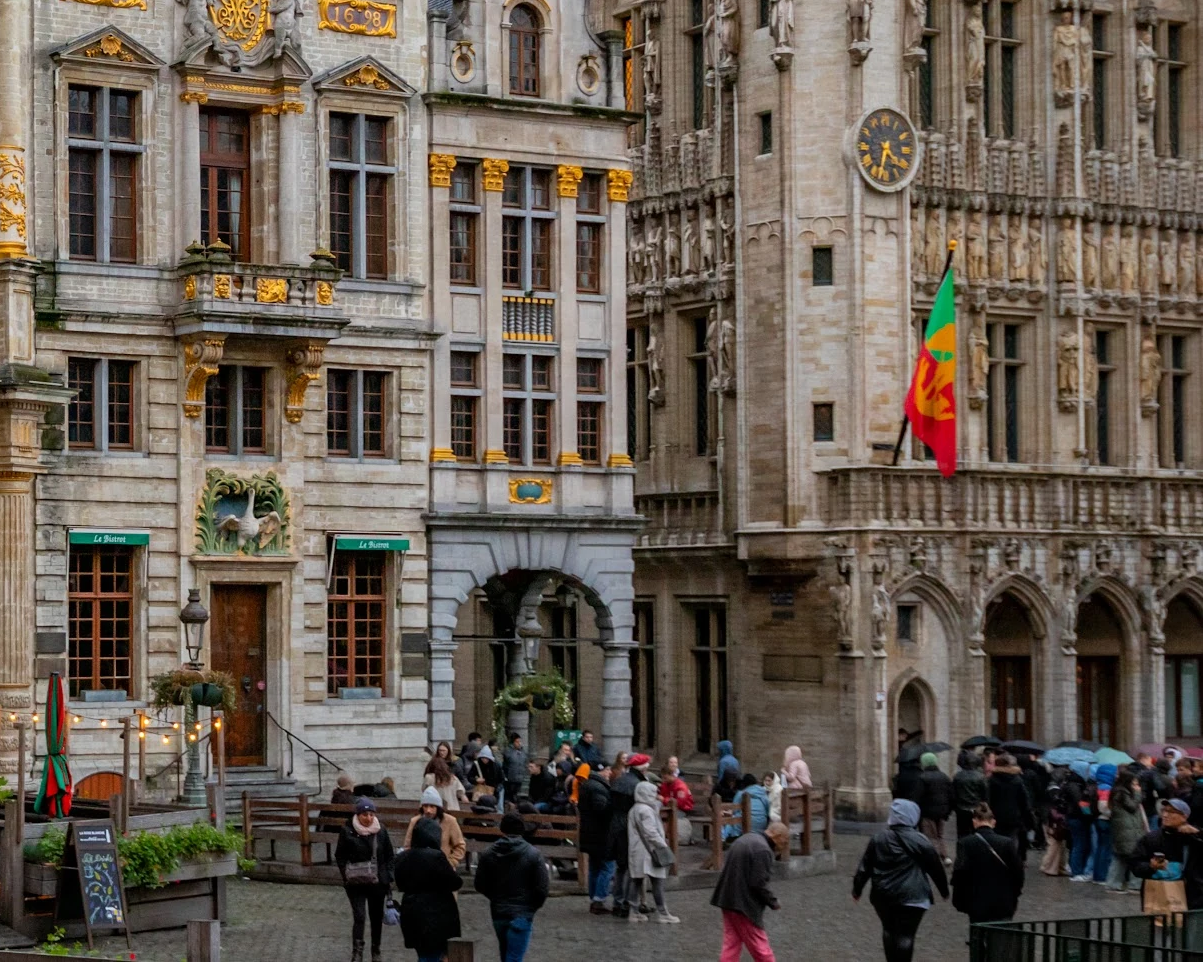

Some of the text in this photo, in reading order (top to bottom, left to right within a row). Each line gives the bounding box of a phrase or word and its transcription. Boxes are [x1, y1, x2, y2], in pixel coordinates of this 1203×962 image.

[93, 534, 127, 544] Le Bistrot
[358, 540, 367, 549] Le
